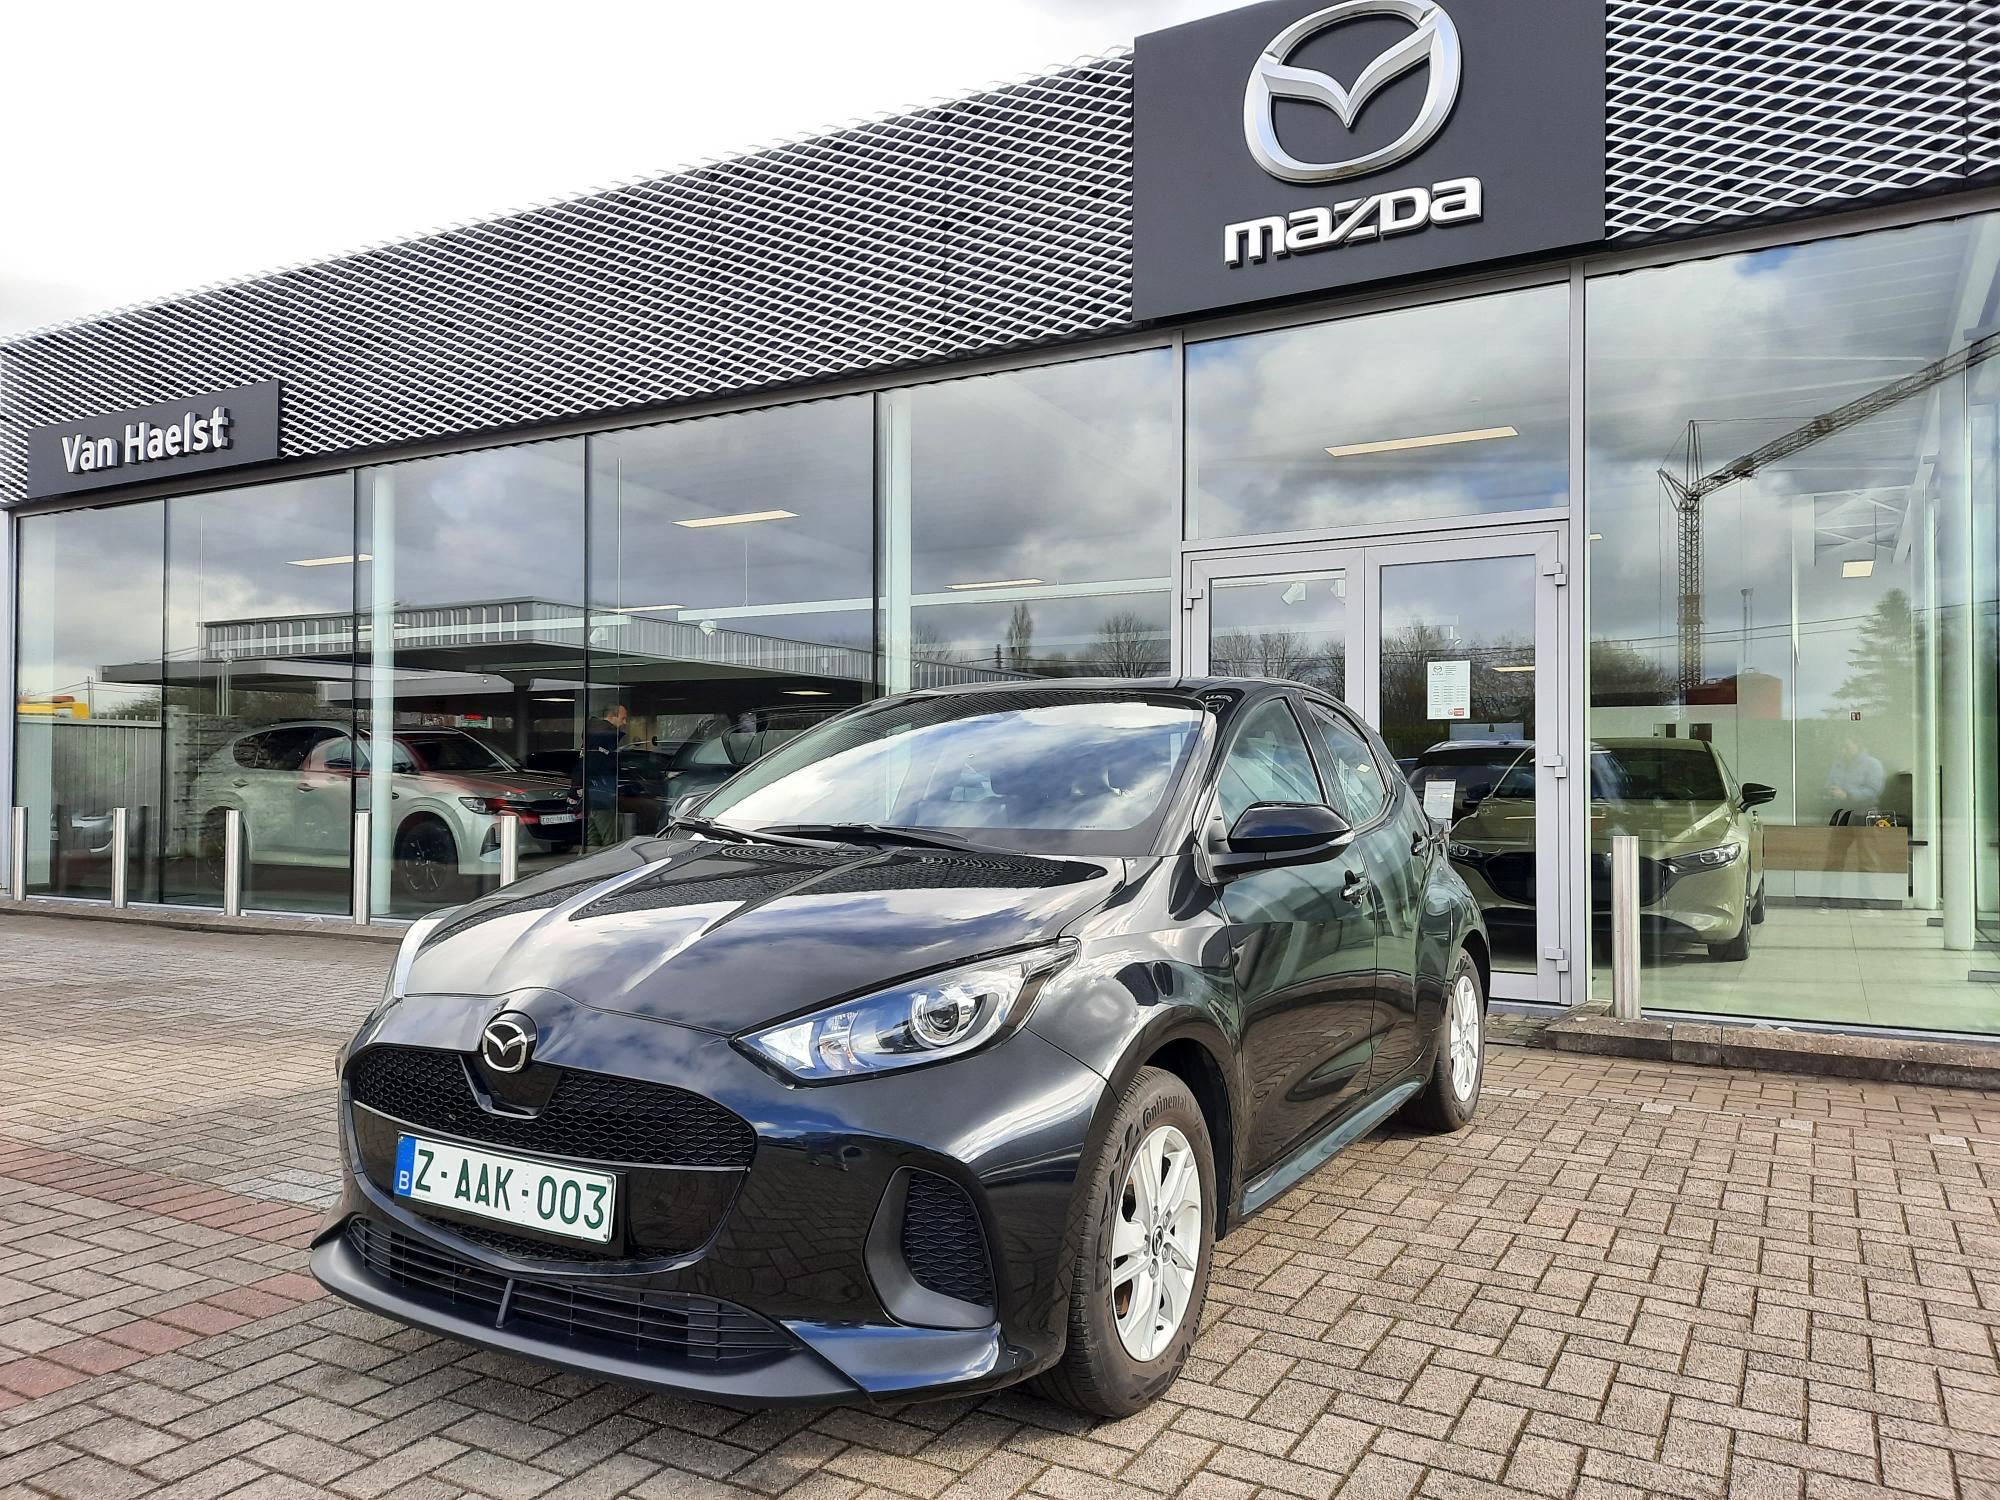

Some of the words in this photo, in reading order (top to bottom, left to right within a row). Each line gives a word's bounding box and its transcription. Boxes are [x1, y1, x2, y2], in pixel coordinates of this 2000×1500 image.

[61, 433, 118, 474] Van
[124, 406, 229, 464] Haelst
[1142, 1093, 1187, 1131] Continental
[398, 1170, 410, 1190] B
